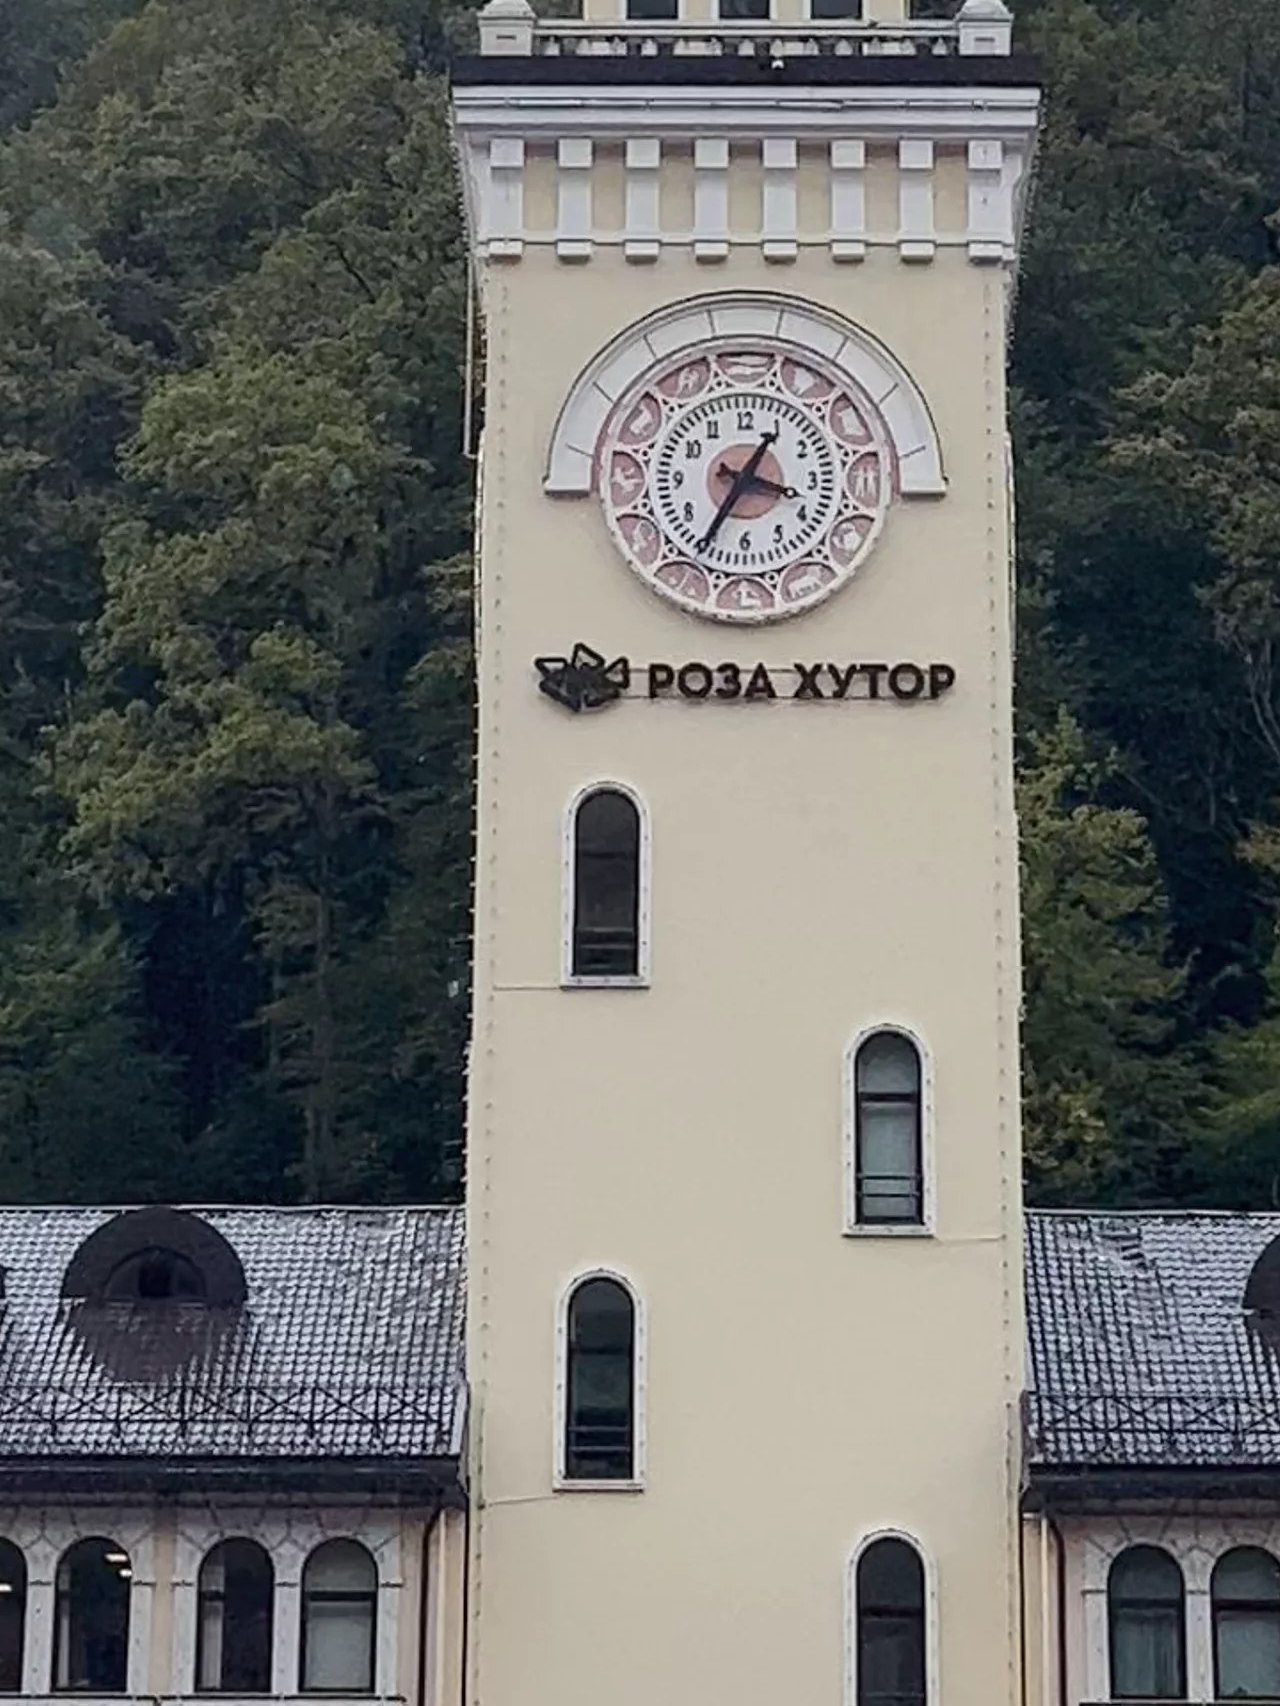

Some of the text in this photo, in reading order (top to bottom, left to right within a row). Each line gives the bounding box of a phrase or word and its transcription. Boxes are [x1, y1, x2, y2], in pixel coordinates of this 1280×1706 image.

[707, 420, 719, 439] 11
[736, 411, 754, 431] 12
[685, 440, 702, 459] 10
[796, 439, 808, 459] 2
[672, 471, 684, 490] 9
[807, 471, 818, 490] 3
[683, 501, 694, 522] 8
[796, 504, 808, 522] 4
[739, 531, 751, 551] 6
[772, 524, 783, 543] 5
[649, 662, 956, 700] РОЗА ХУТОР
